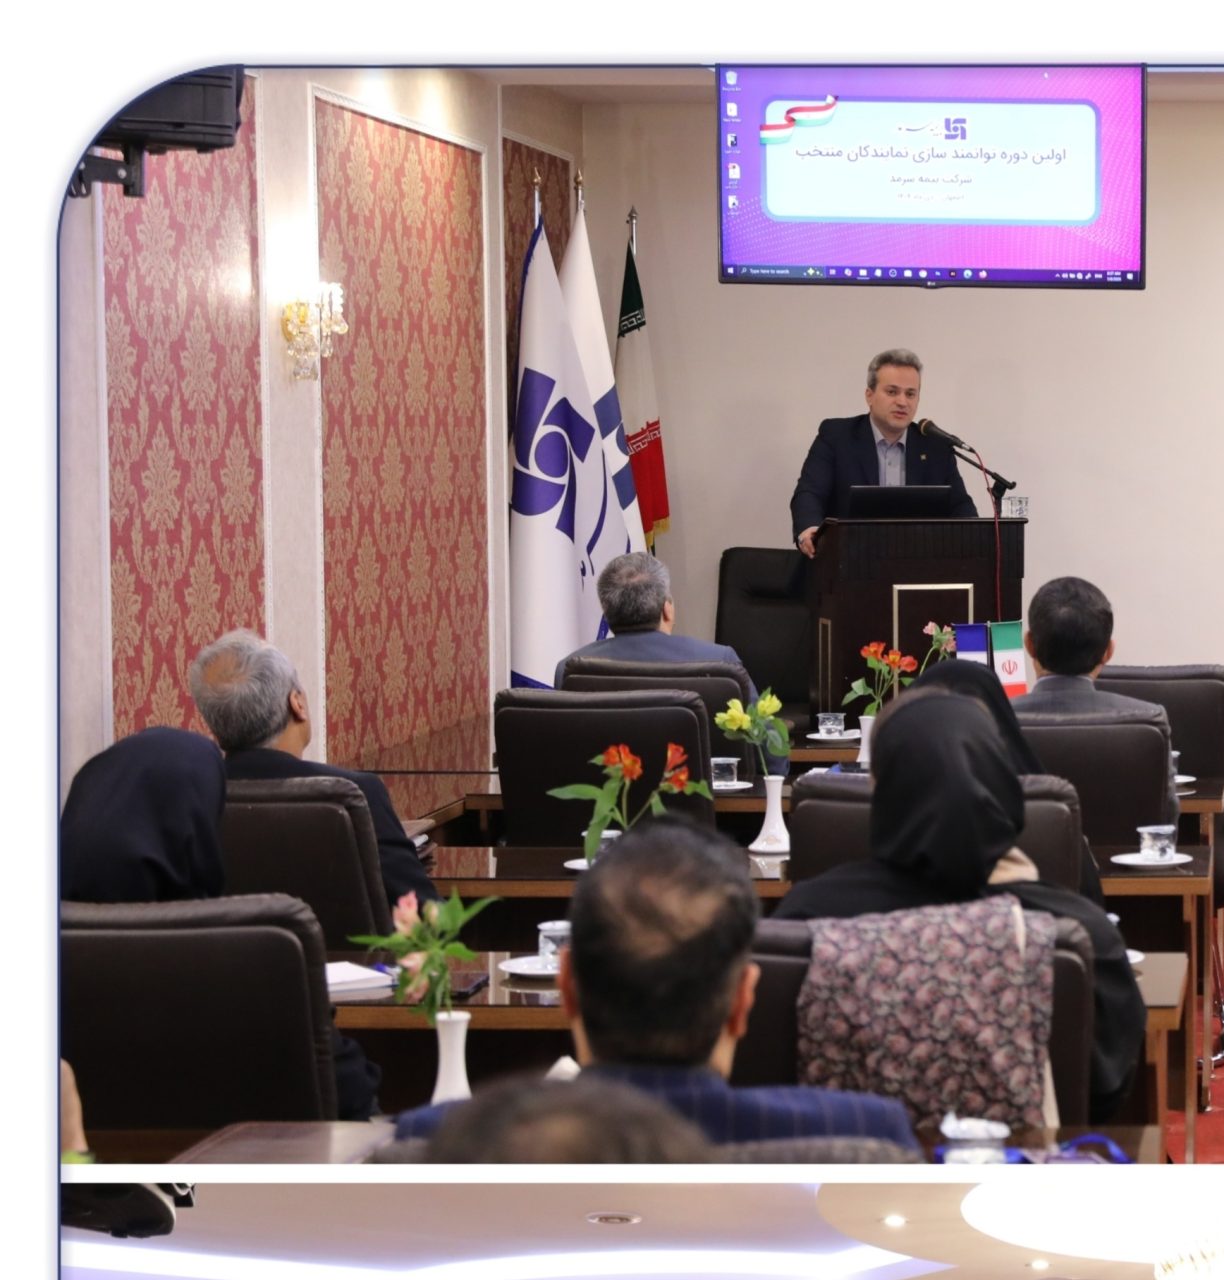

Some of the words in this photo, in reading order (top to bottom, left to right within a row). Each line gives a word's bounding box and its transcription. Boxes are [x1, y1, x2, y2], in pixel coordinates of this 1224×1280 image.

[795, 144, 843, 158] منتخب
[913, 147, 947, 163] سازی
[952, 147, 996, 162] توانمند
[1001, 150, 1028, 163] دوره
